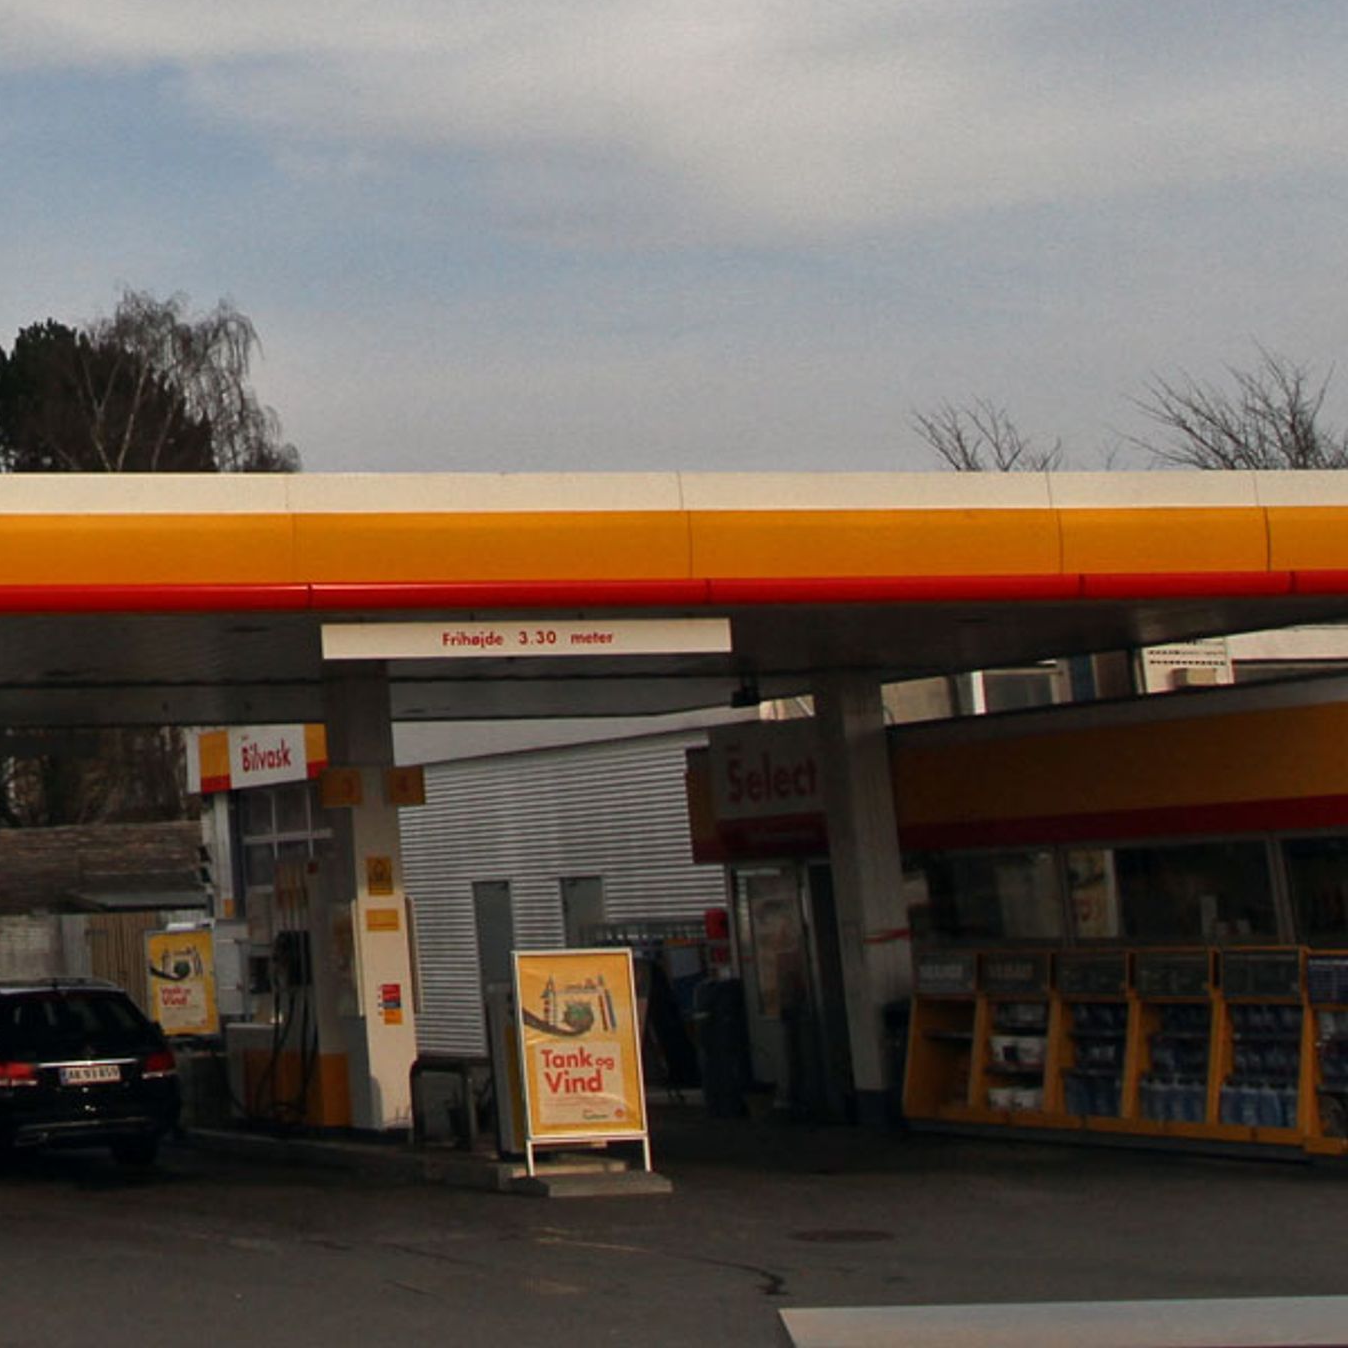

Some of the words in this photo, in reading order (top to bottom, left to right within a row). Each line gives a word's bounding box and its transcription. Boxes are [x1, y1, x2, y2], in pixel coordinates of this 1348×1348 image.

[442, 631, 503, 648] Frihøjde
[518, 630, 557, 645] 3.30
[570, 632, 613, 645] meter
[240, 739, 292, 772] Bilvask
[727, 751, 817, 802] Select
[541, 1047, 592, 1068] Tank
[595, 1056, 615, 1071] og
[544, 1069, 603, 1093] Vind
